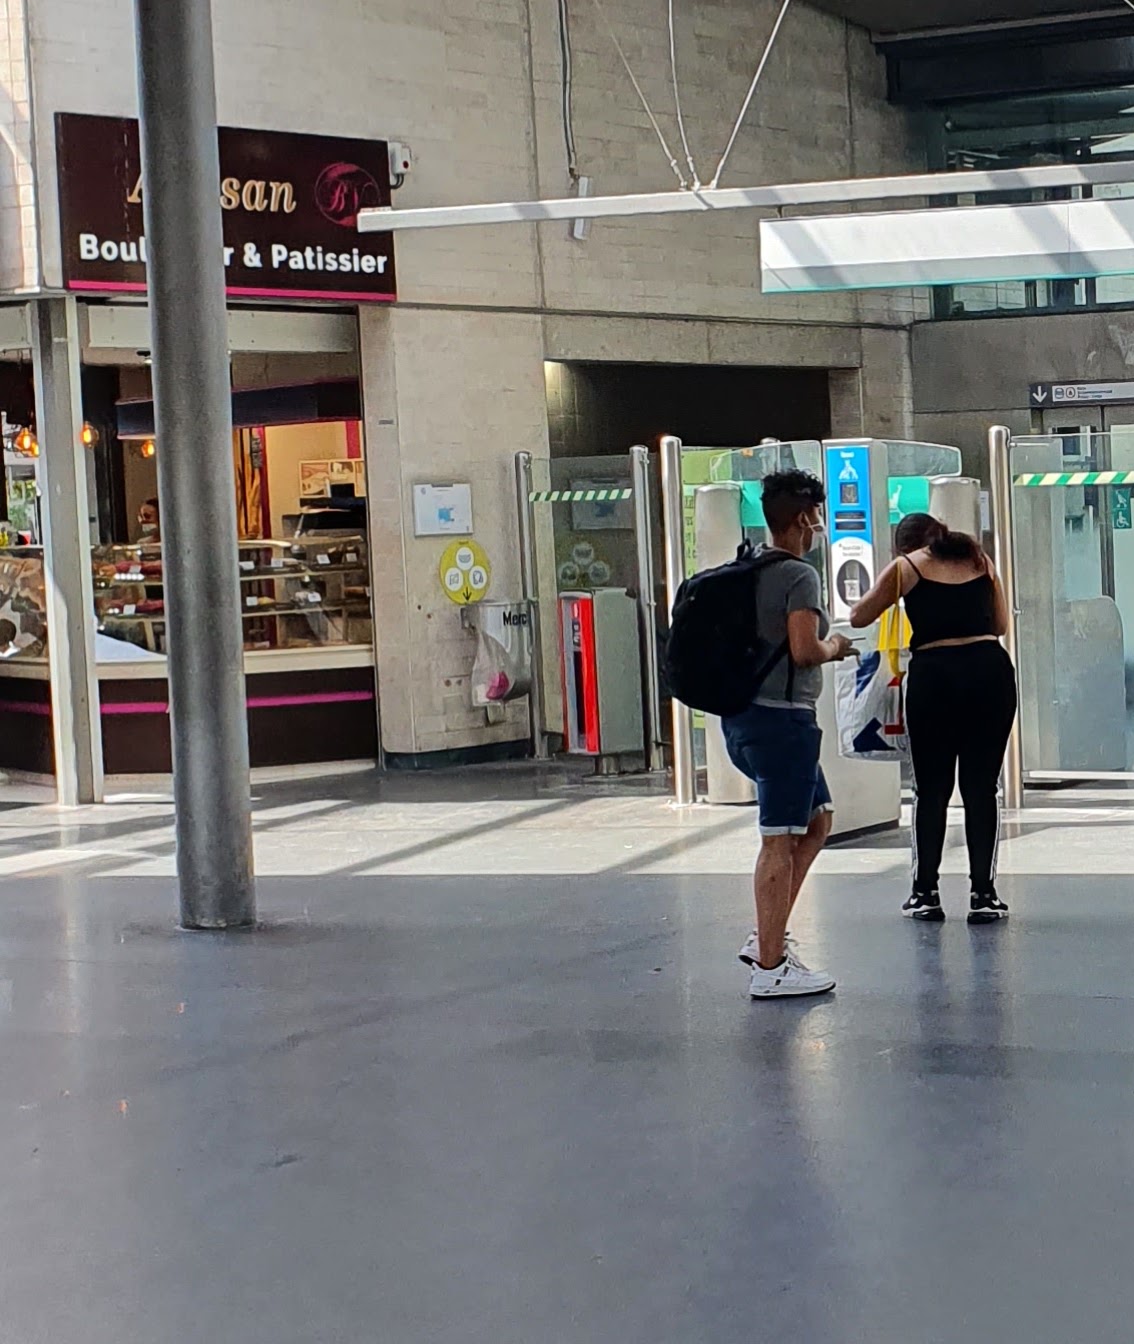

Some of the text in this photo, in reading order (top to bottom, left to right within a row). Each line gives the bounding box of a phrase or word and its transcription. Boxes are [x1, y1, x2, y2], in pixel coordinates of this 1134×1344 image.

[79, 233, 388, 274] Boulr & Patissier
[502, 611, 528, 626] Merc
